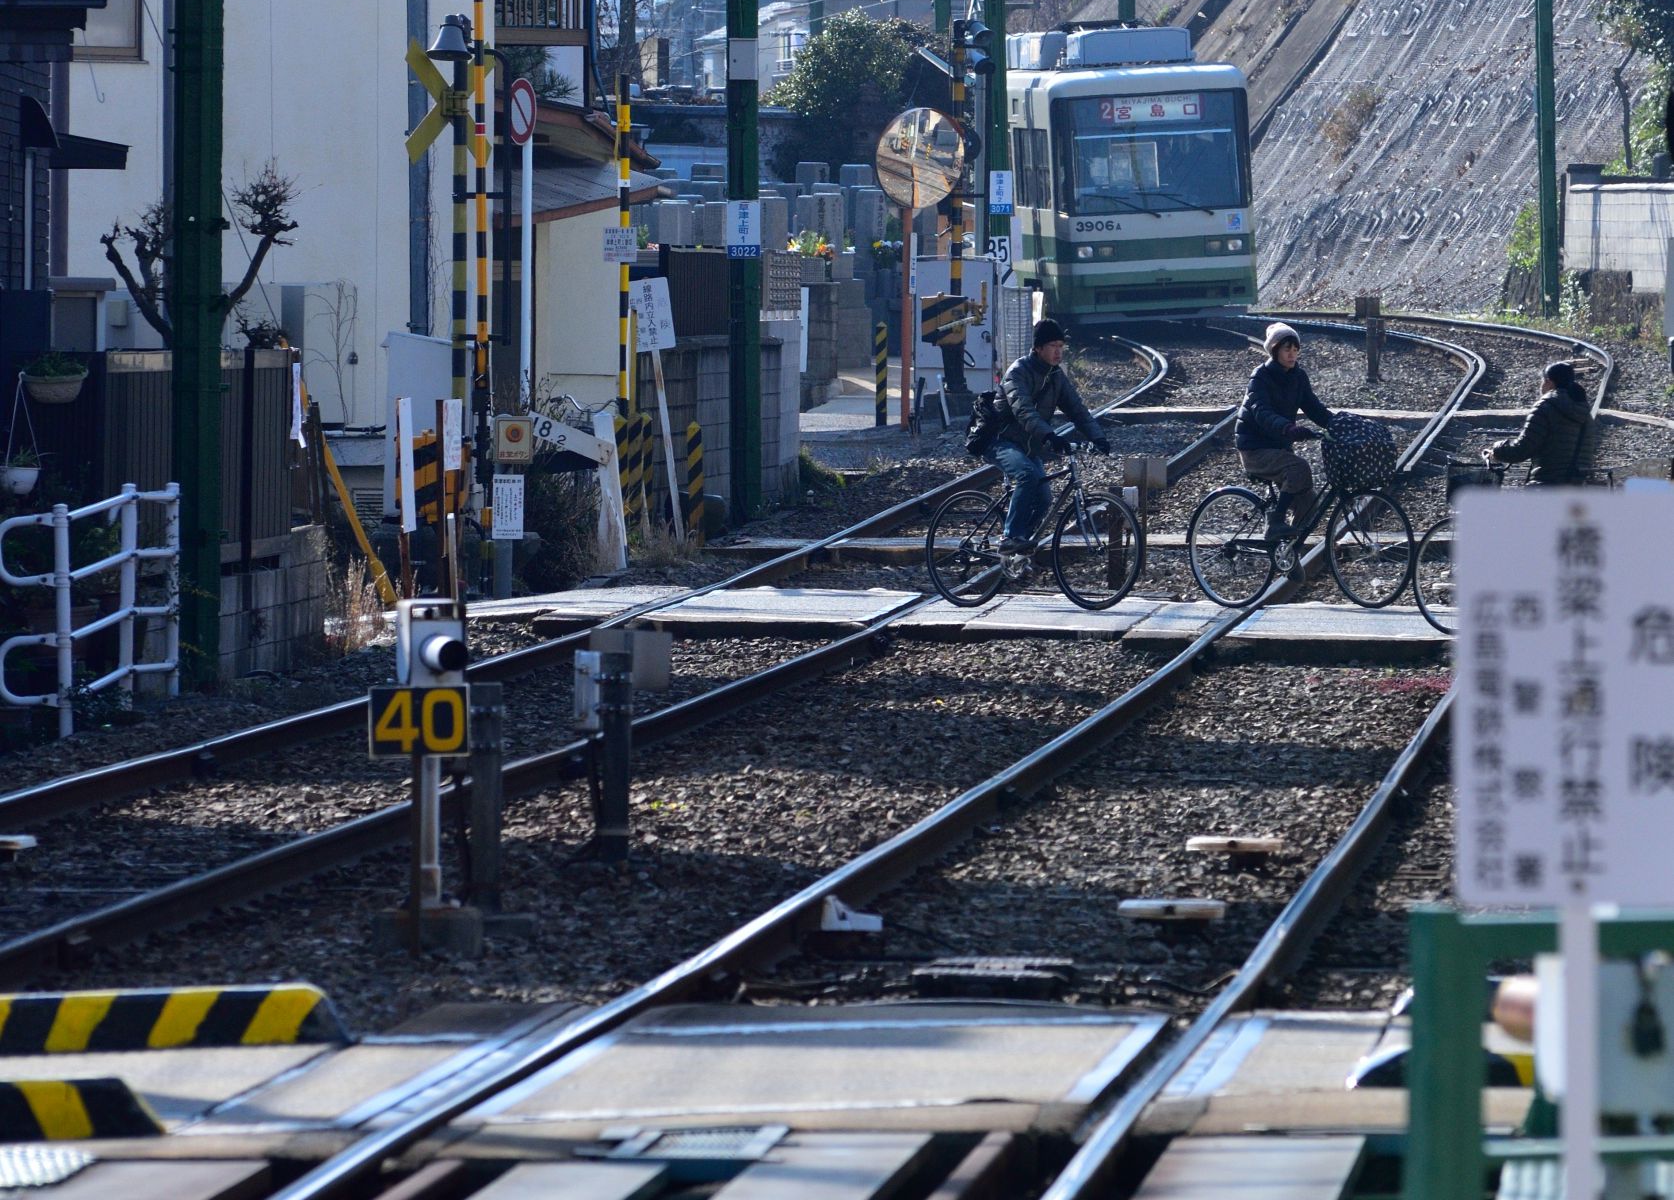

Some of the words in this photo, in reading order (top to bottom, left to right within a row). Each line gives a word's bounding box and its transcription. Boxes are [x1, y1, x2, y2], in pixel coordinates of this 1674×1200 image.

[1101, 103, 1112, 120] 2
[1116, 103, 1198, 120] 宮島口
[991, 204, 1010, 213] 3071
[1075, 220, 1122, 233] 3906A
[642, 284, 659, 345] 線路内立入禁止
[375, 688, 465, 753] 40
